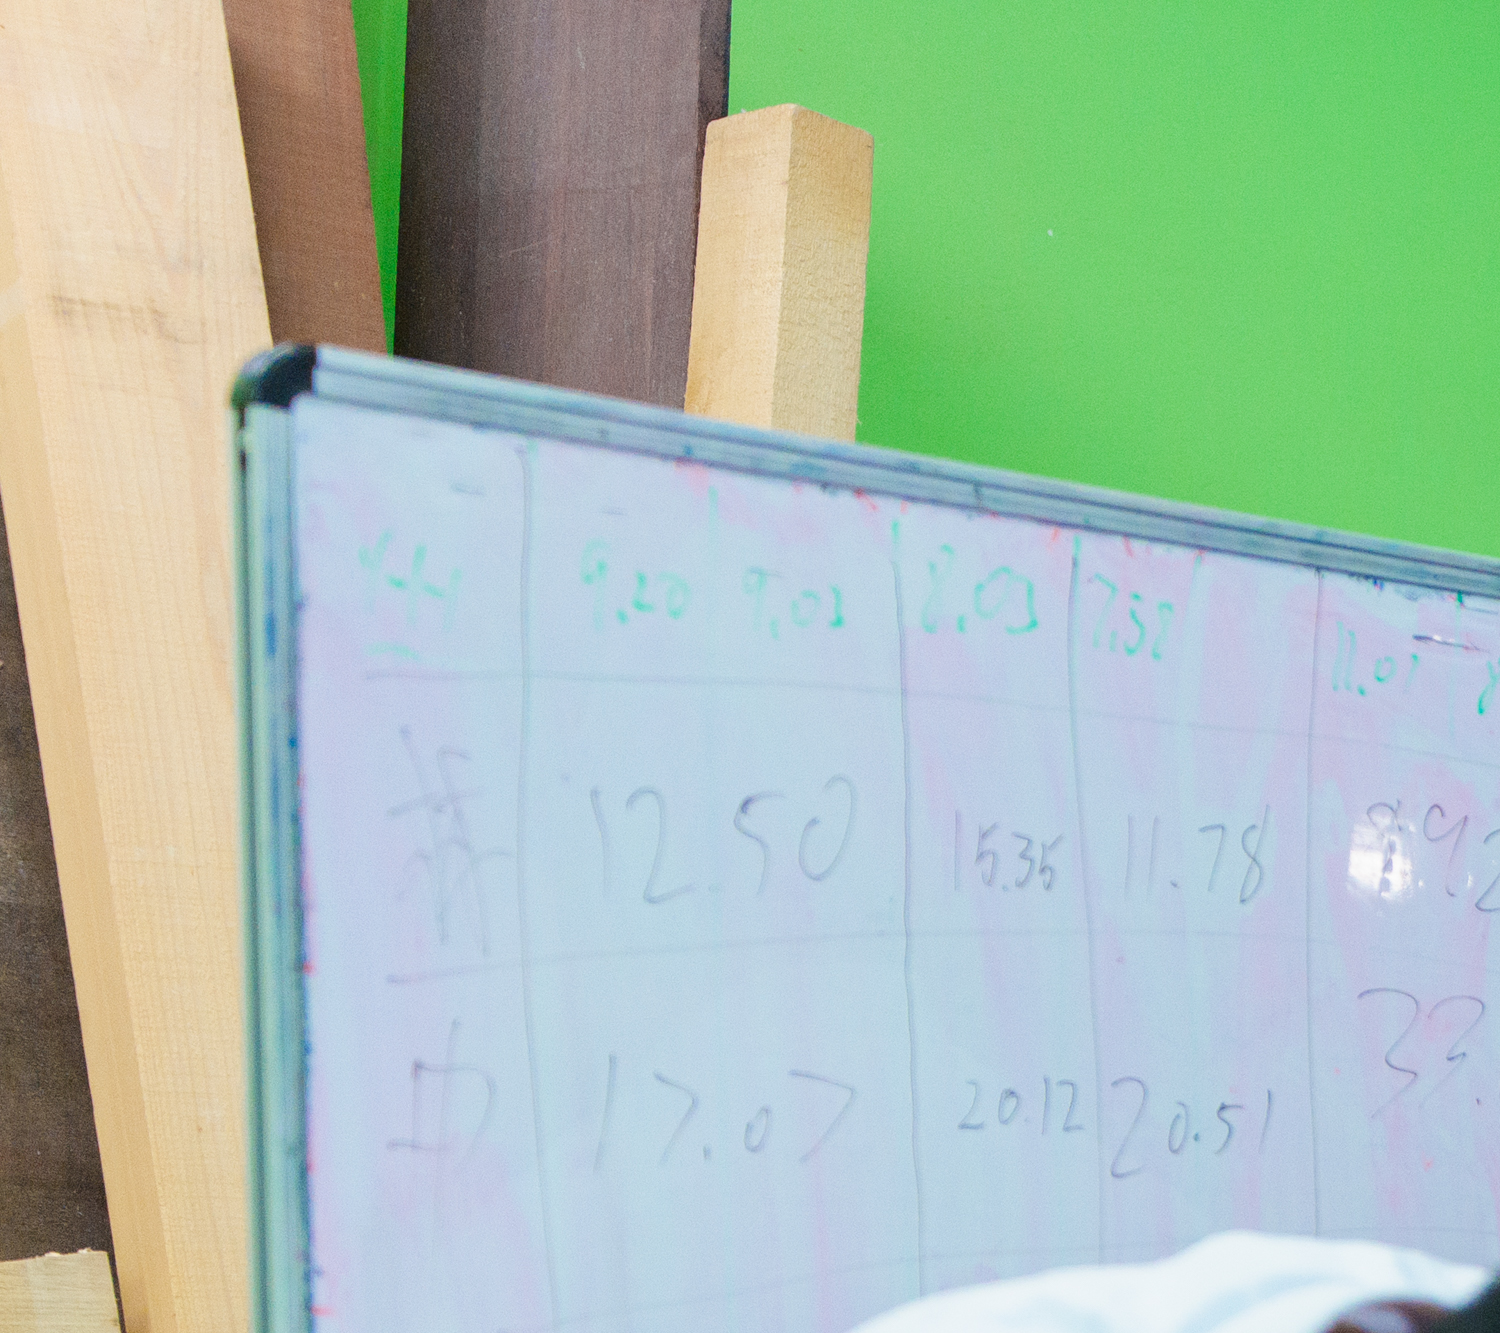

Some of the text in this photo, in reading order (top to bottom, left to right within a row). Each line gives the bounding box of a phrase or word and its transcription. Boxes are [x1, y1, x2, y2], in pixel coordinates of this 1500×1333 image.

[1124, 803, 1270, 905] 11.78
[957, 1076, 1085, 1137] 20.12
[1108, 1075, 1274, 1178] 20.51
